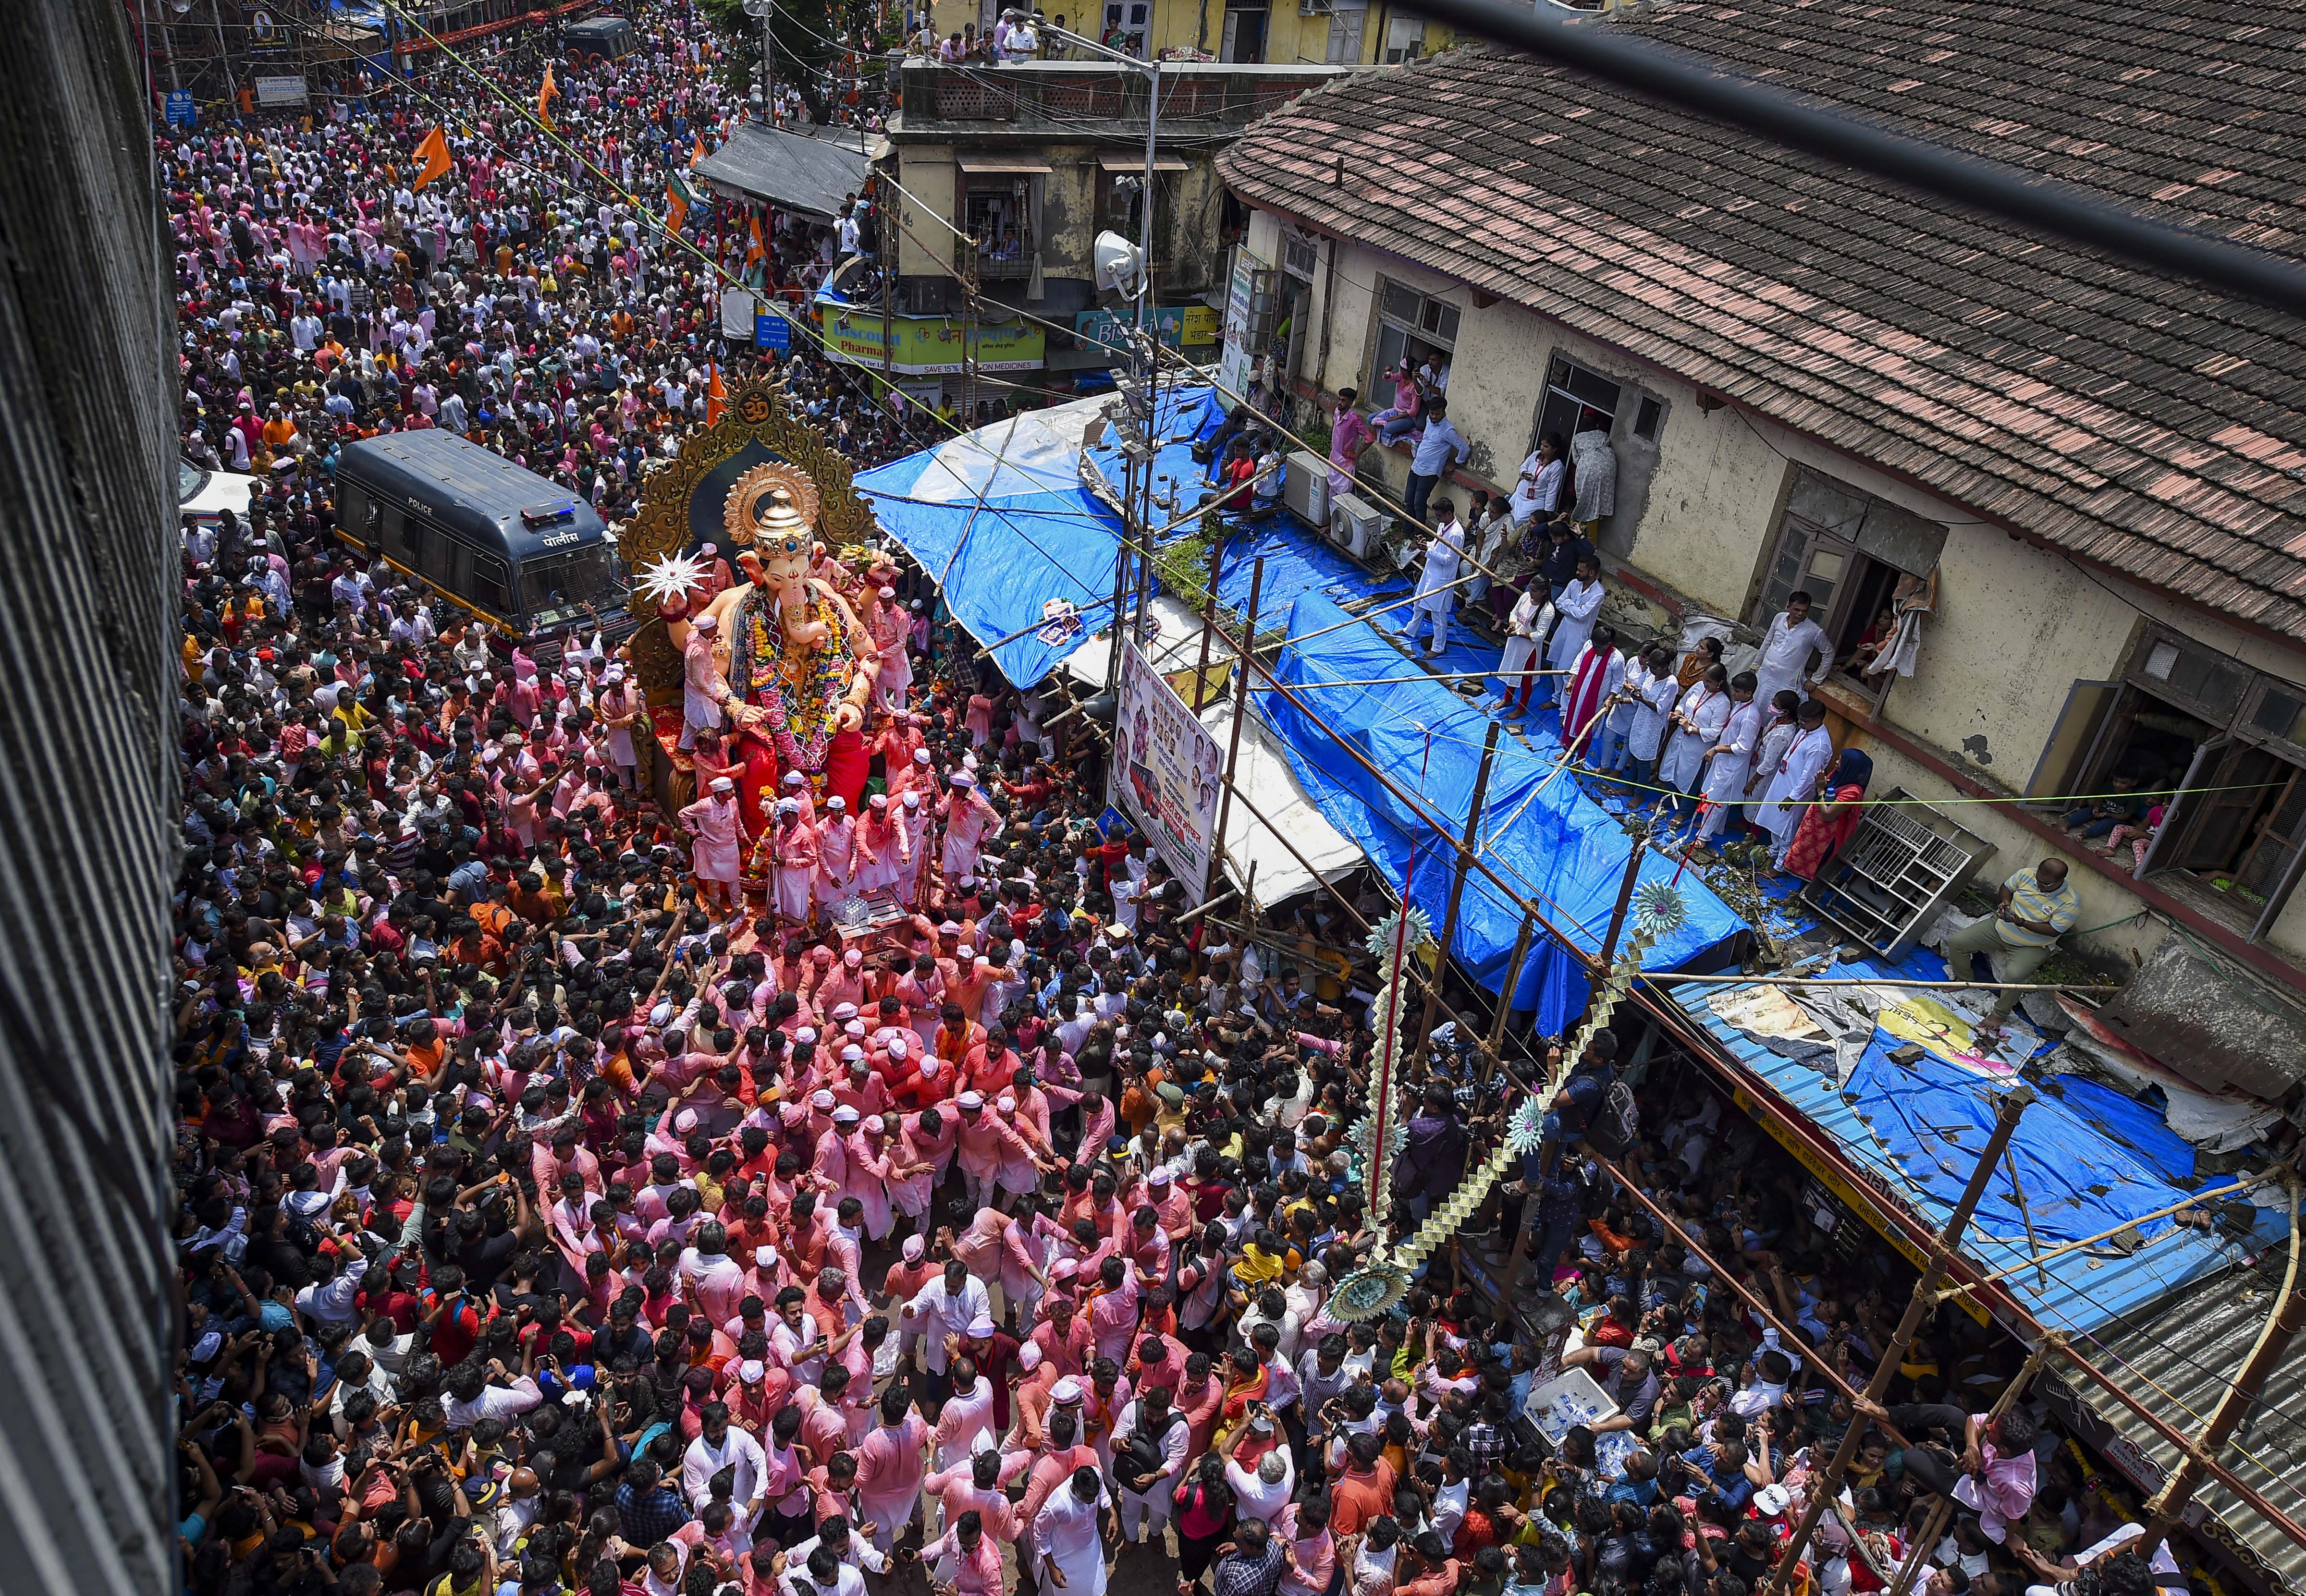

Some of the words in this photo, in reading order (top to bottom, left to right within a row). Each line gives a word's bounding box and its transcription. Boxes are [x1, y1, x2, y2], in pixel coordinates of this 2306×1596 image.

[1098, 318, 1153, 343] Bisri
[408, 497, 432, 516] POLICE
[542, 532, 579, 547] पोलीस
[344, 542, 368, 561] MUMBAI
[481, 621, 513, 644] MOILE-1
[1151, 675, 1164, 701] भारतीय
[1165, 692, 1176, 714] जनता
[1176, 705, 1185, 726] पार्टी
[1182, 815, 1201, 849] मोफत
[1786, 1136, 1800, 1153] आणि
[1858, 1202, 1899, 1243] KHETESH
[1913, 1253, 1919, 1262] &
[1957, 1292, 1979, 1315] STORE
[1765, 1489, 1779, 1505] Dope
[2201, 1519, 2264, 1578] Salon
